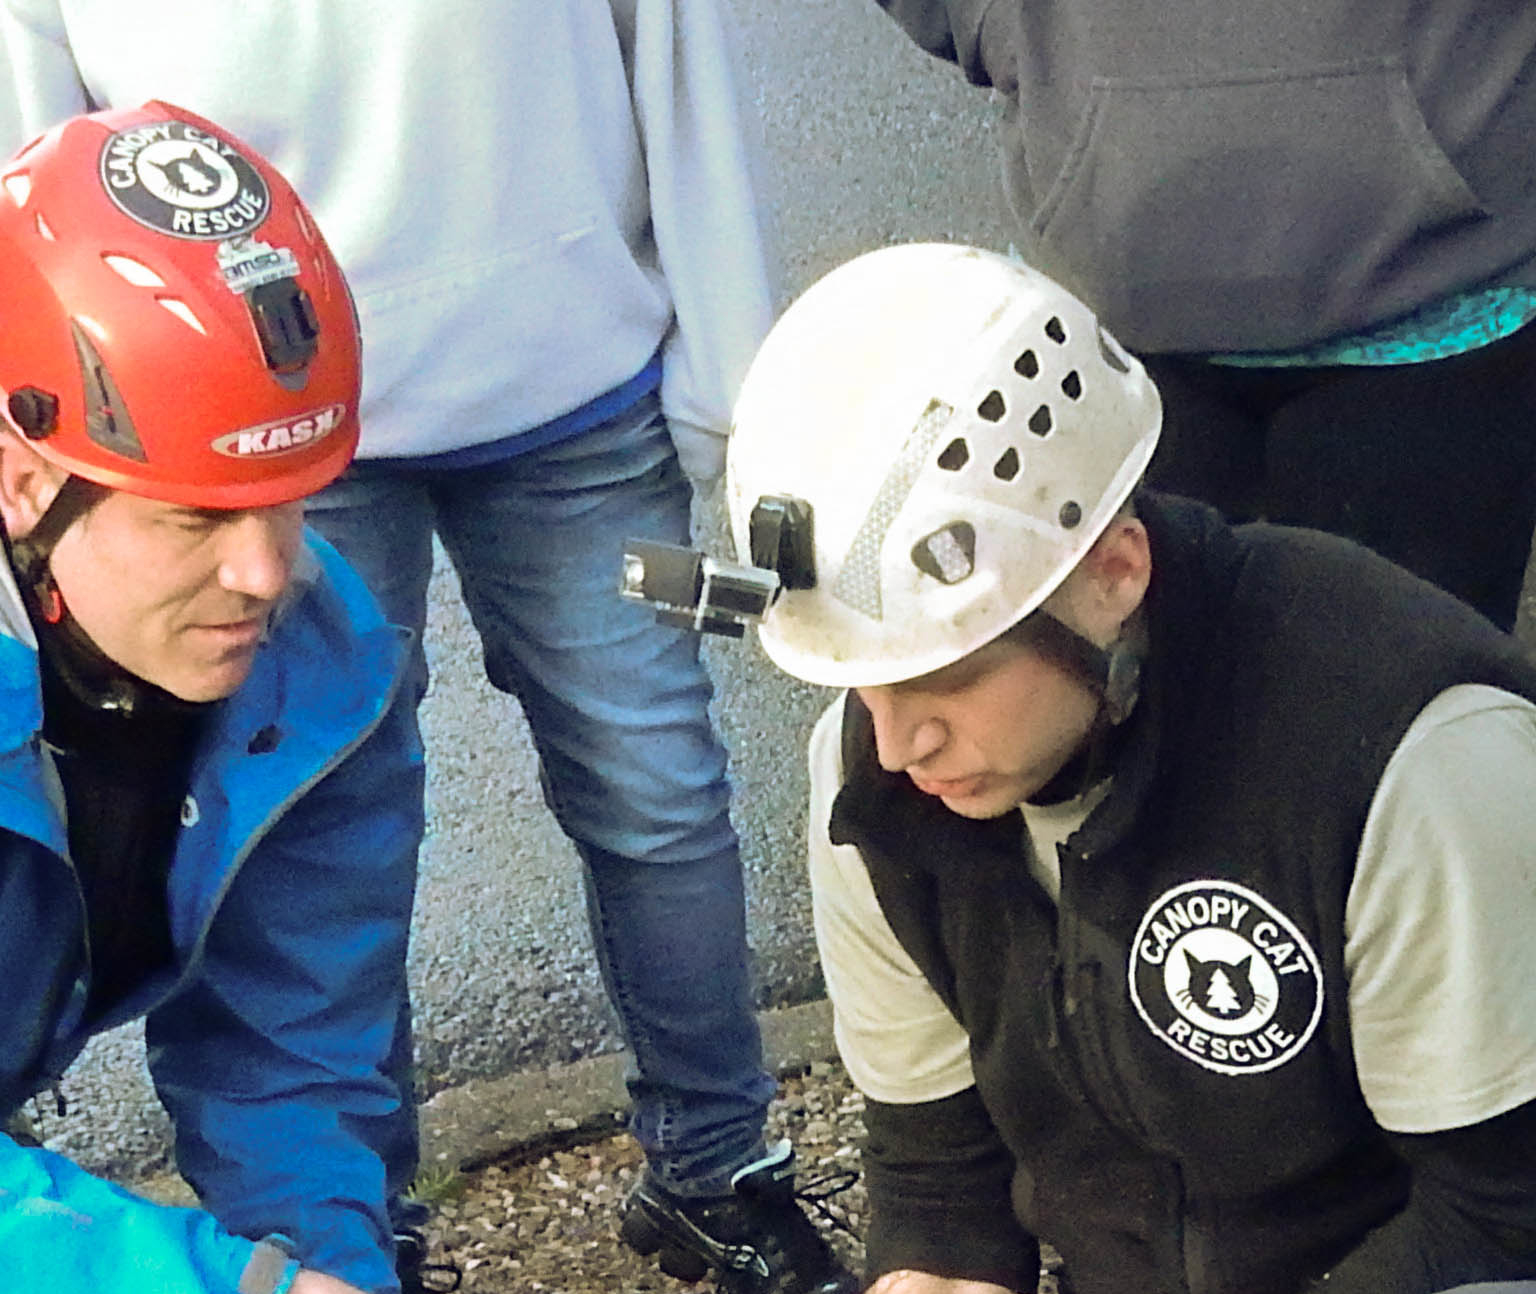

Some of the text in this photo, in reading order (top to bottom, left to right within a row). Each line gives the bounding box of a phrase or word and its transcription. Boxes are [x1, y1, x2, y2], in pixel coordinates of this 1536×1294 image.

[108, 126, 171, 188] CANOPY
[172, 188, 263, 234] RESCUE
[1140, 895, 1309, 975] CANOPY CAT
[1166, 1018, 1295, 1062] RESCUE
